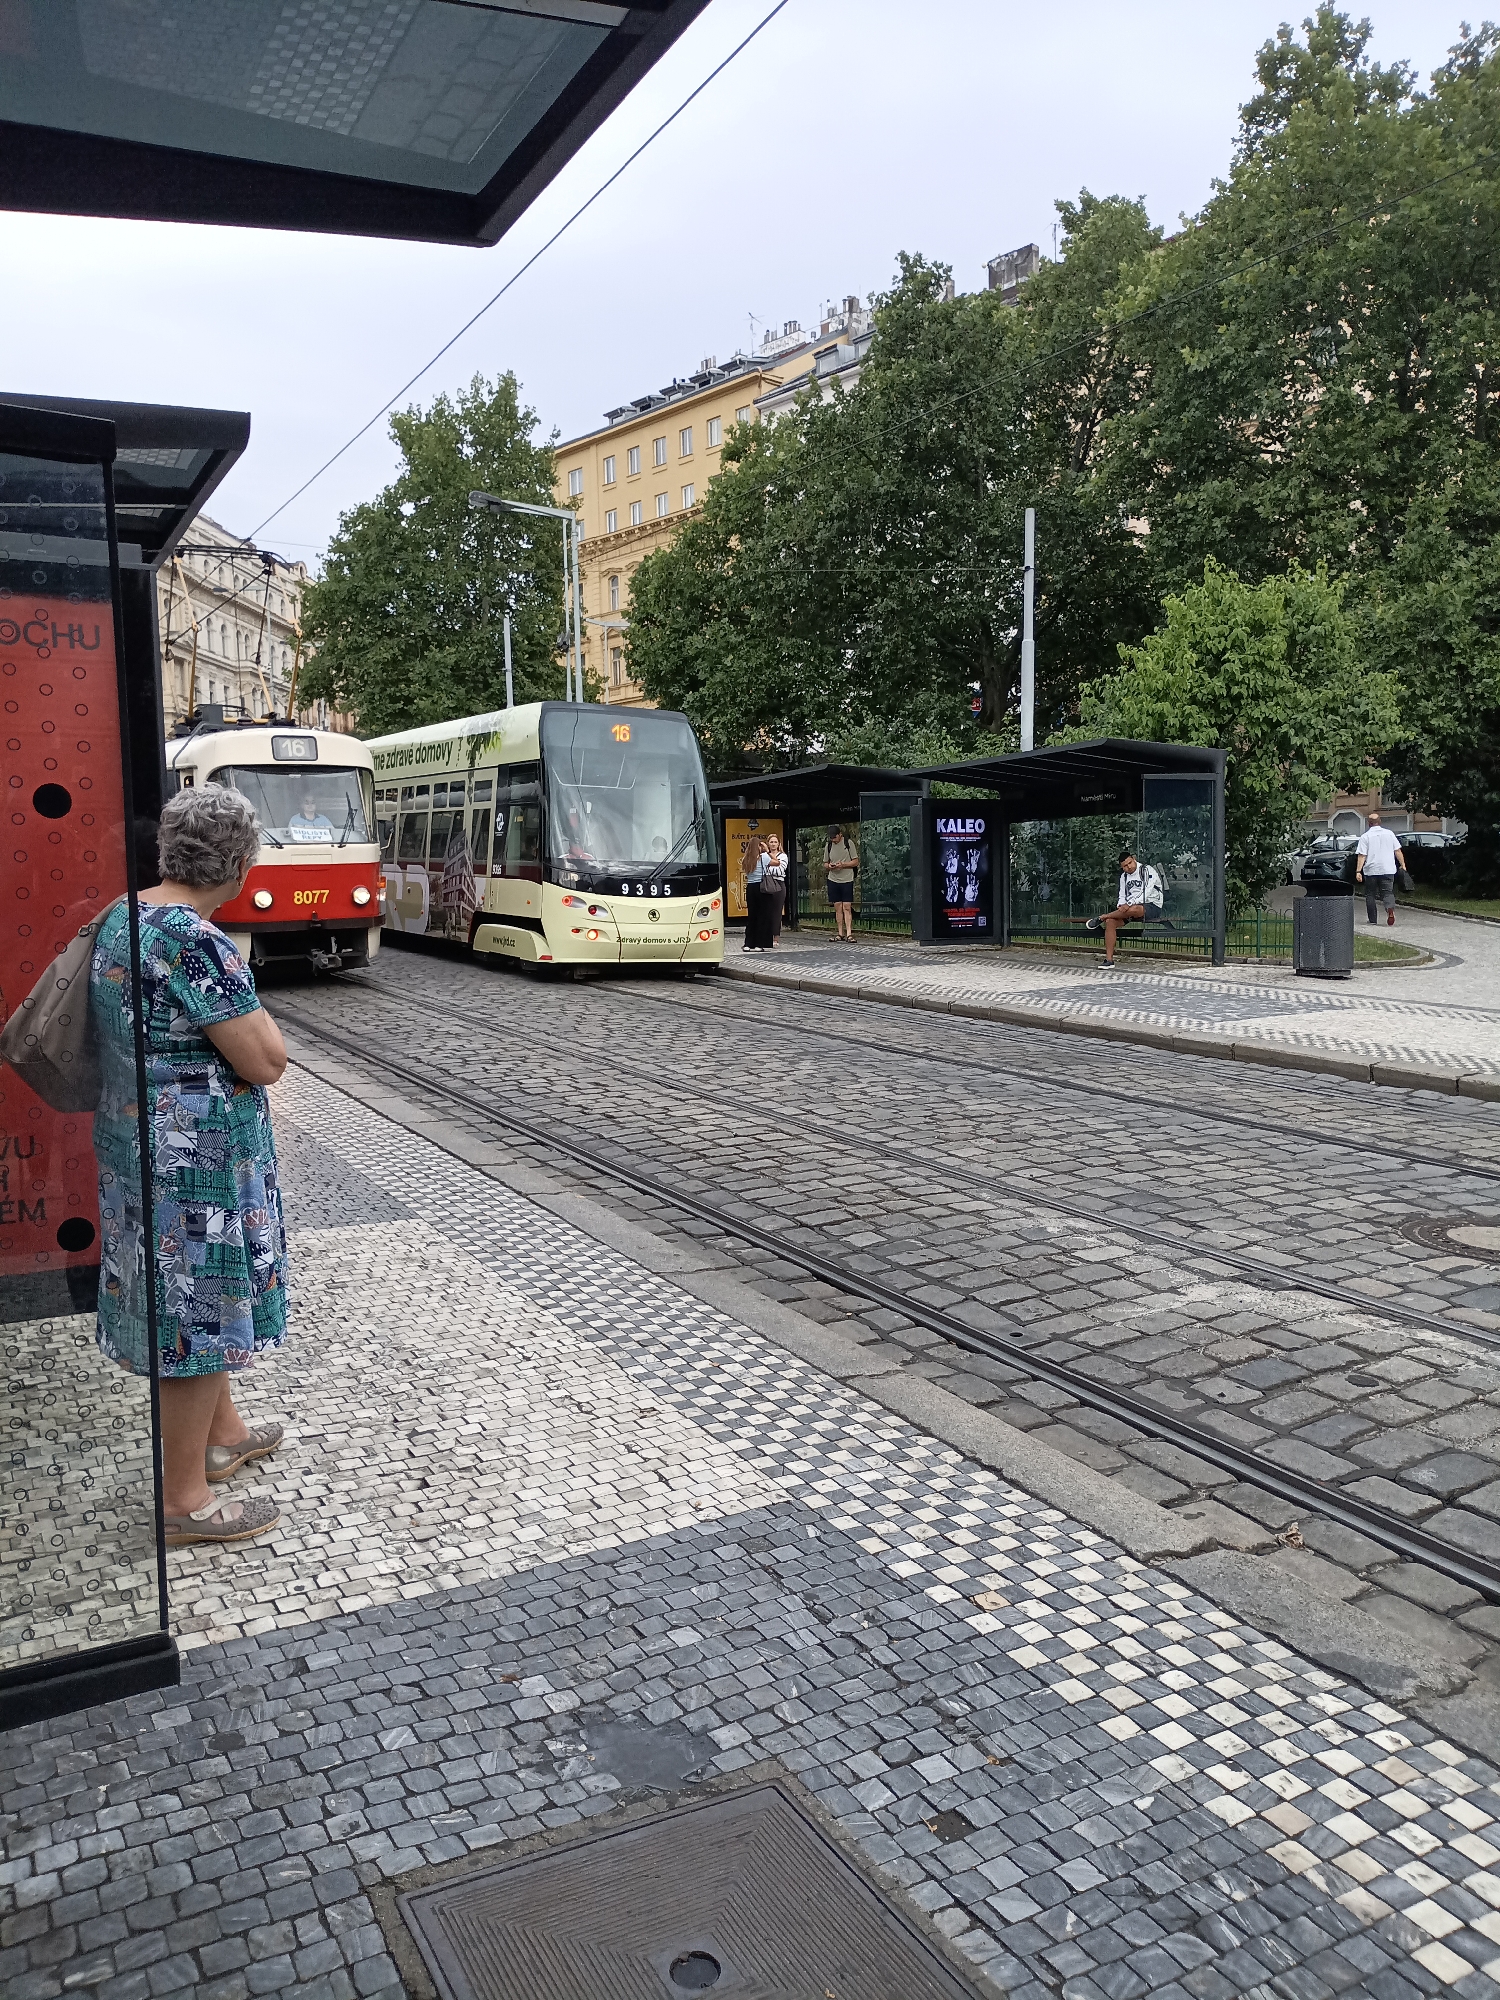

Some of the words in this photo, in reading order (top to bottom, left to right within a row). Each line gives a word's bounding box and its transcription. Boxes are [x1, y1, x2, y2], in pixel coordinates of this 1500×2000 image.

[611, 723, 631, 743] 16
[282, 738, 306, 758] 16
[385, 742, 414, 770] zdravé
[415, 740, 453, 767] domovy
[936, 818, 986, 834] KALEO
[293, 889, 330, 905] 8077
[621, 883, 671, 896] 9395
